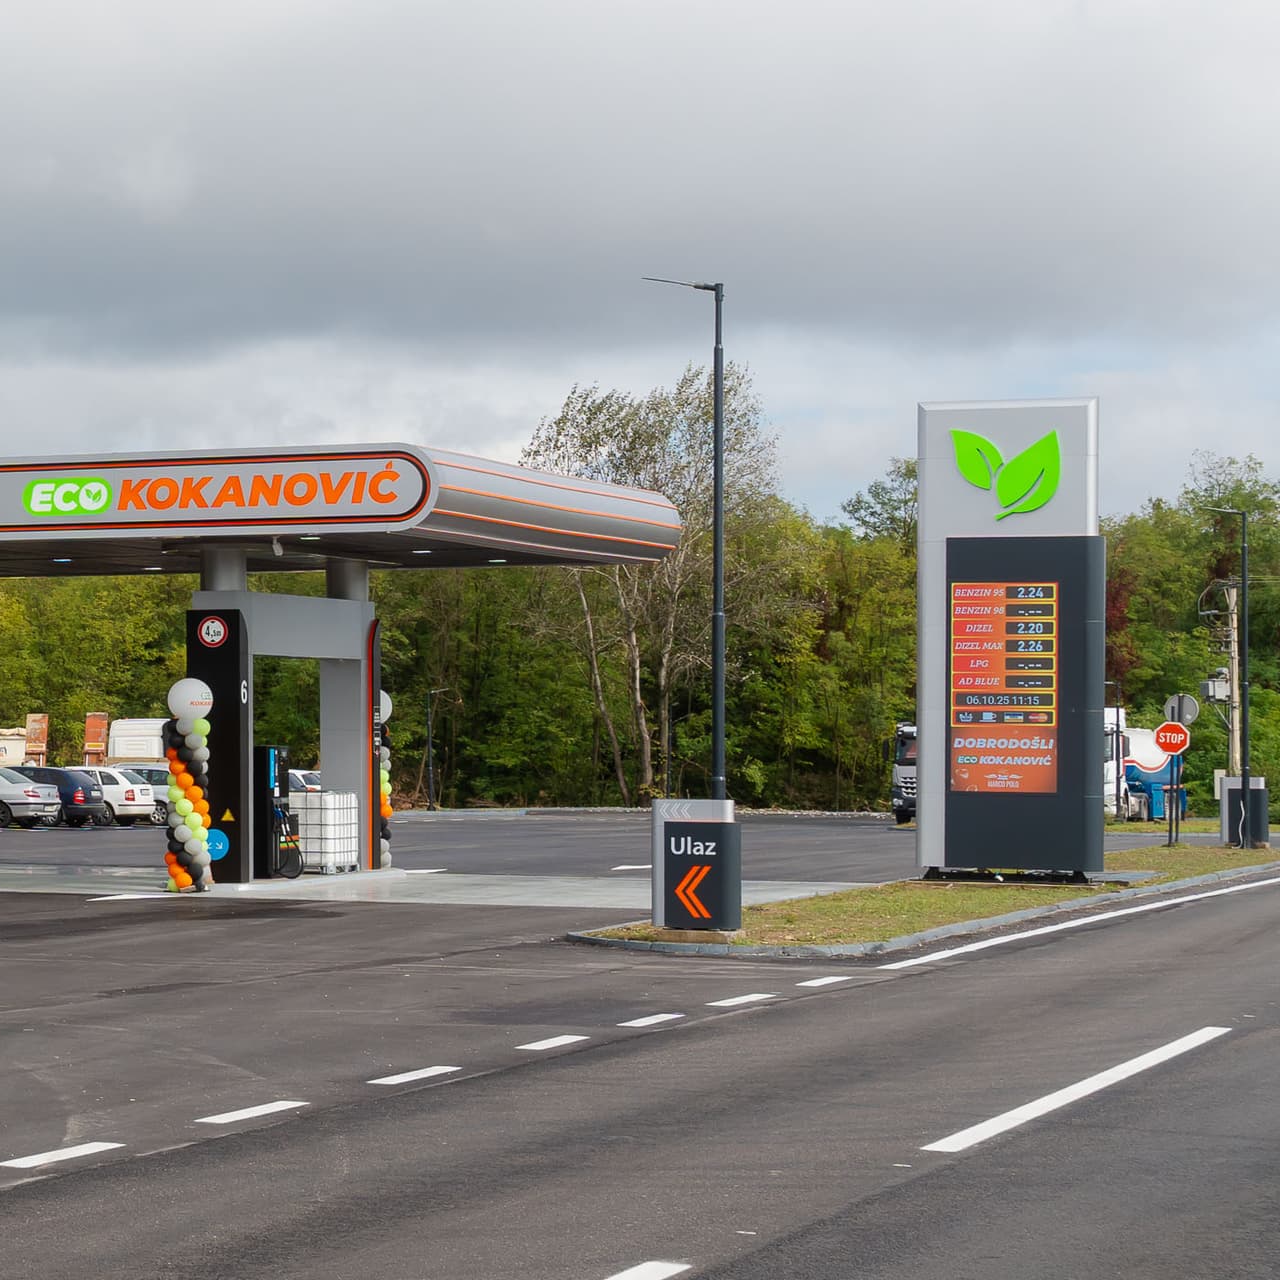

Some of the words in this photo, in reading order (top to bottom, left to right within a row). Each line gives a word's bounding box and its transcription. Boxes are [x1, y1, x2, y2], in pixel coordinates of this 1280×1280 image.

[30, 482, 108, 513] ECO
[117, 461, 401, 511] KOKANOVIĆ
[954, 588, 991, 597] BENZIN
[1017, 587, 1044, 598] 2.24
[954, 606, 991, 615] BENZIN
[965, 624, 993, 632] DIZEL
[1017, 623, 1044, 634] 2.20
[1017, 640, 1044, 652] 2.26
[970, 659, 989, 668] LPG
[959, 677, 973, 685] AD
[975, 677, 1000, 685] BLUE
[241, 679, 248, 704] 6
[966, 695, 1010, 705] 06.10.25
[1012, 695, 1040, 705] 11:15
[953, 736, 1054, 749] DOBRODOŠLI
[1159, 732, 1185, 744] STOP
[957, 756, 978, 764] ECO
[979, 755, 1052, 766] KOKANOVIĆ
[670, 836, 717, 855] Ulaz
